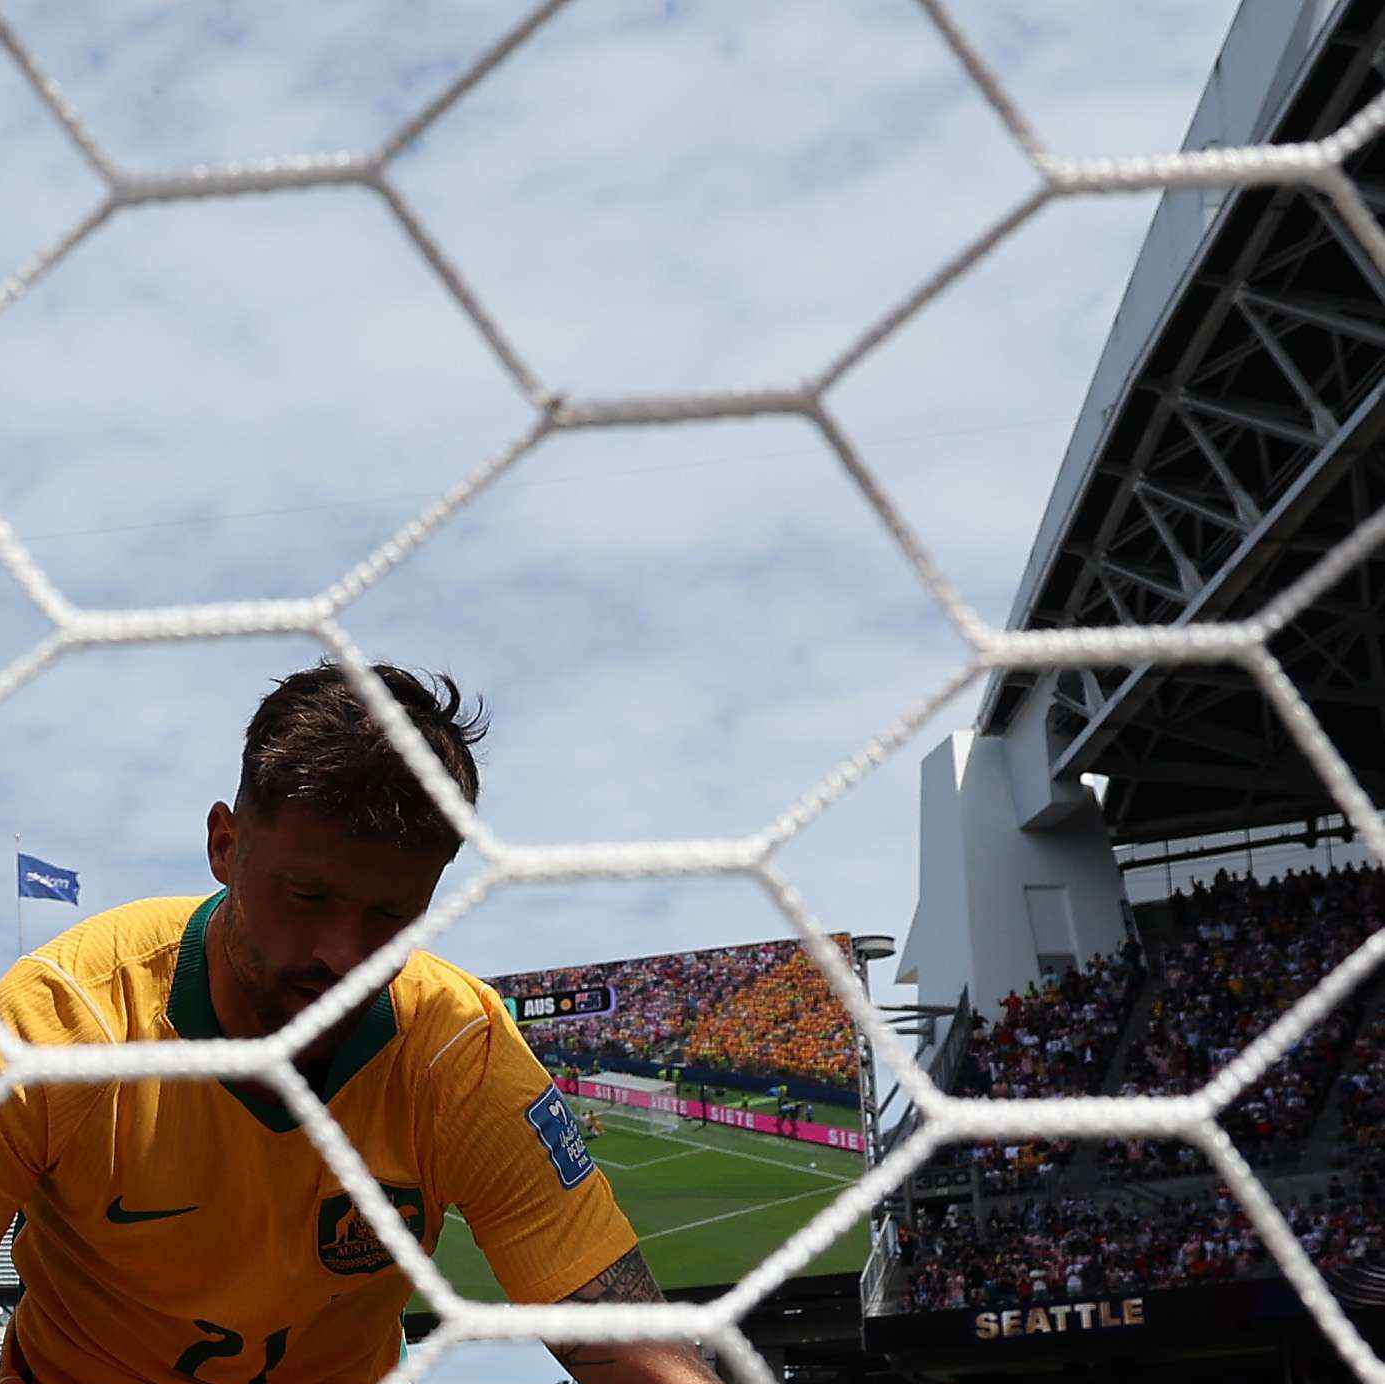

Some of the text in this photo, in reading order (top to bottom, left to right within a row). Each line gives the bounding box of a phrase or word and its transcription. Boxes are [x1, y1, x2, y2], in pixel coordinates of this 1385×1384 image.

[524, 997, 556, 1017] AUS
[710, 1107, 755, 1128] SIETE
[828, 1129, 860, 1148] SIE
[975, 1297, 1145, 1340] SEATTLE
